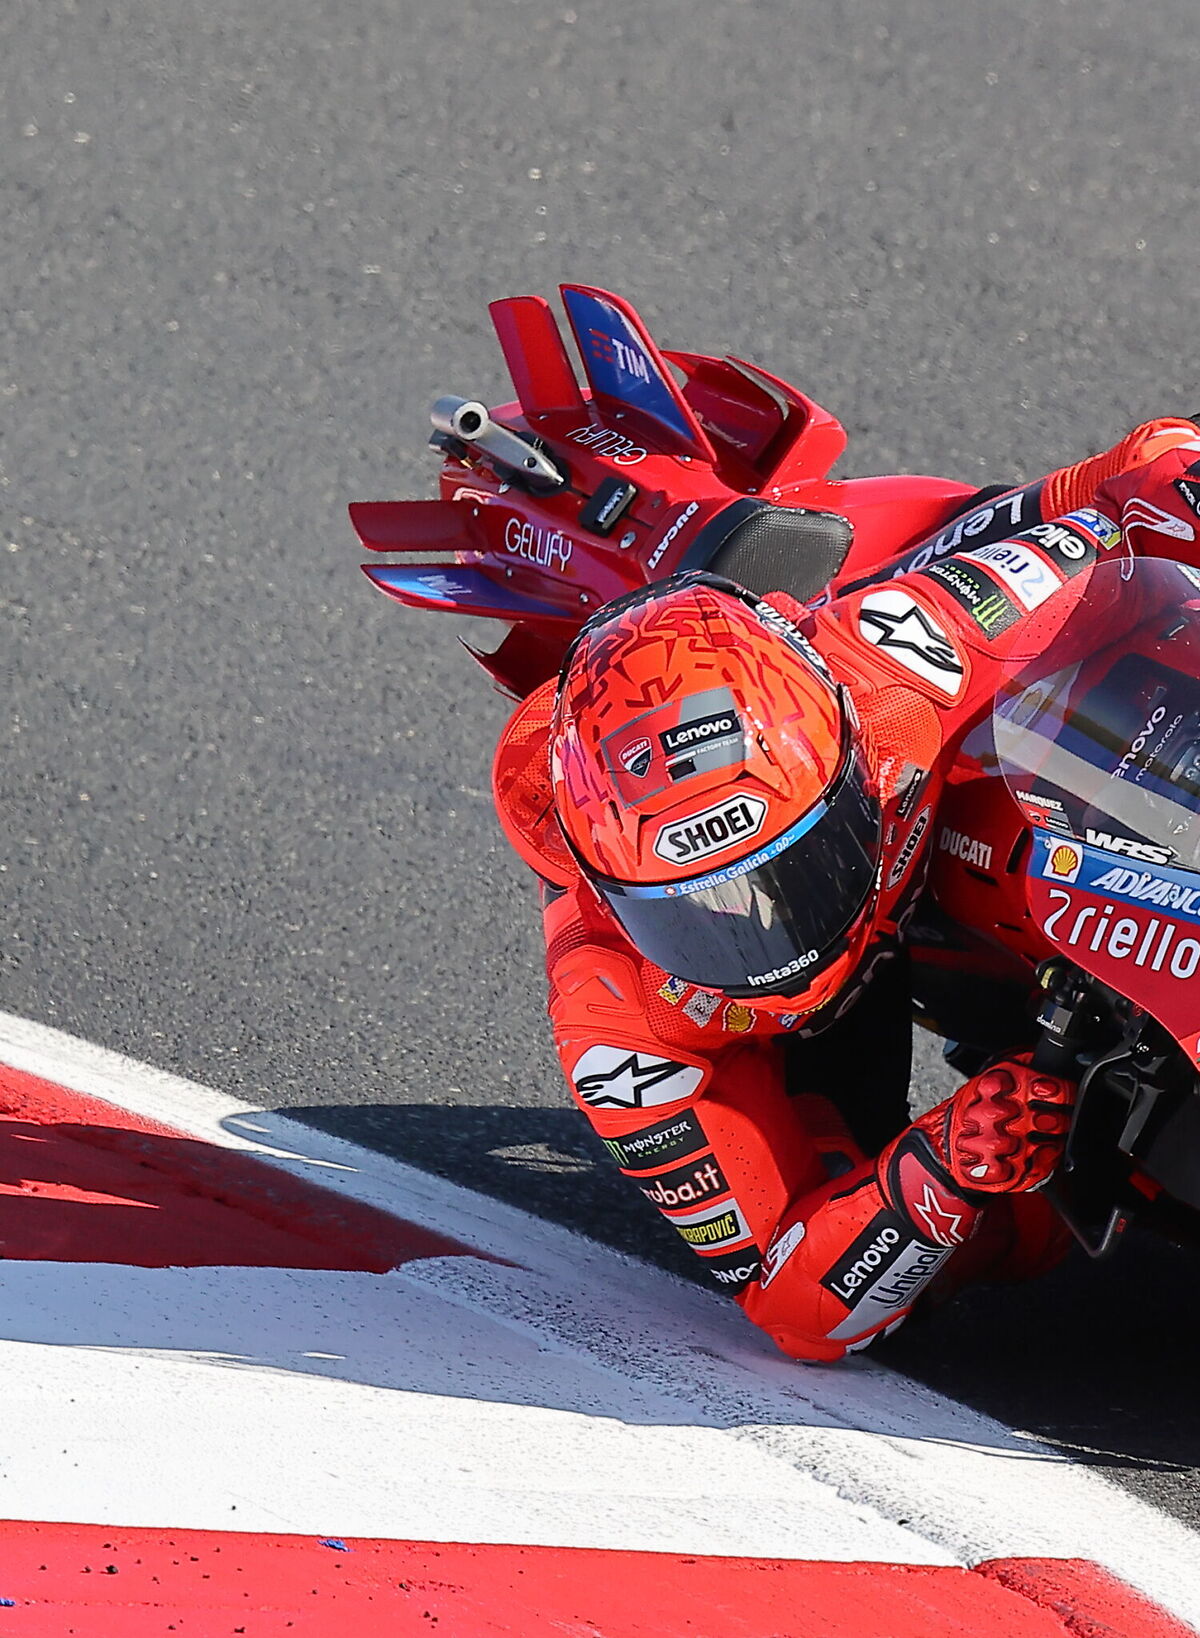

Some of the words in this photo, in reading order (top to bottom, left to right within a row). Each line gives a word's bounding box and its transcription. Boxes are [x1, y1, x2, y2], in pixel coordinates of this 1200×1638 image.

[612, 338, 650, 384] TIM
[566, 422, 648, 466] GELLIFY
[505, 518, 572, 572] GELLIFY
[647, 501, 700, 570] DUCATI
[622, 740, 648, 760] DUCATI
[665, 719, 733, 748] Lenovo
[696, 741, 722, 755] FACTORY
[1111, 706, 1167, 780] enovo
[1135, 714, 1184, 782] motorola
[1016, 790, 1064, 812] MARQUEZ
[669, 803, 755, 858] SHOEI
[892, 815, 927, 879] SHOEI
[940, 826, 993, 870] DUCATI
[1086, 829, 1172, 866] WRS
[679, 873, 727, 895] Estrella
[726, 852, 770, 879] Galicia
[747, 949, 819, 987] Insta360
[1036, 1014, 1062, 1034] domino
[623, 1121, 691, 1152] MONSTER
[831, 1228, 899, 1299] Lenovo
[870, 1245, 946, 1303] Unipol
